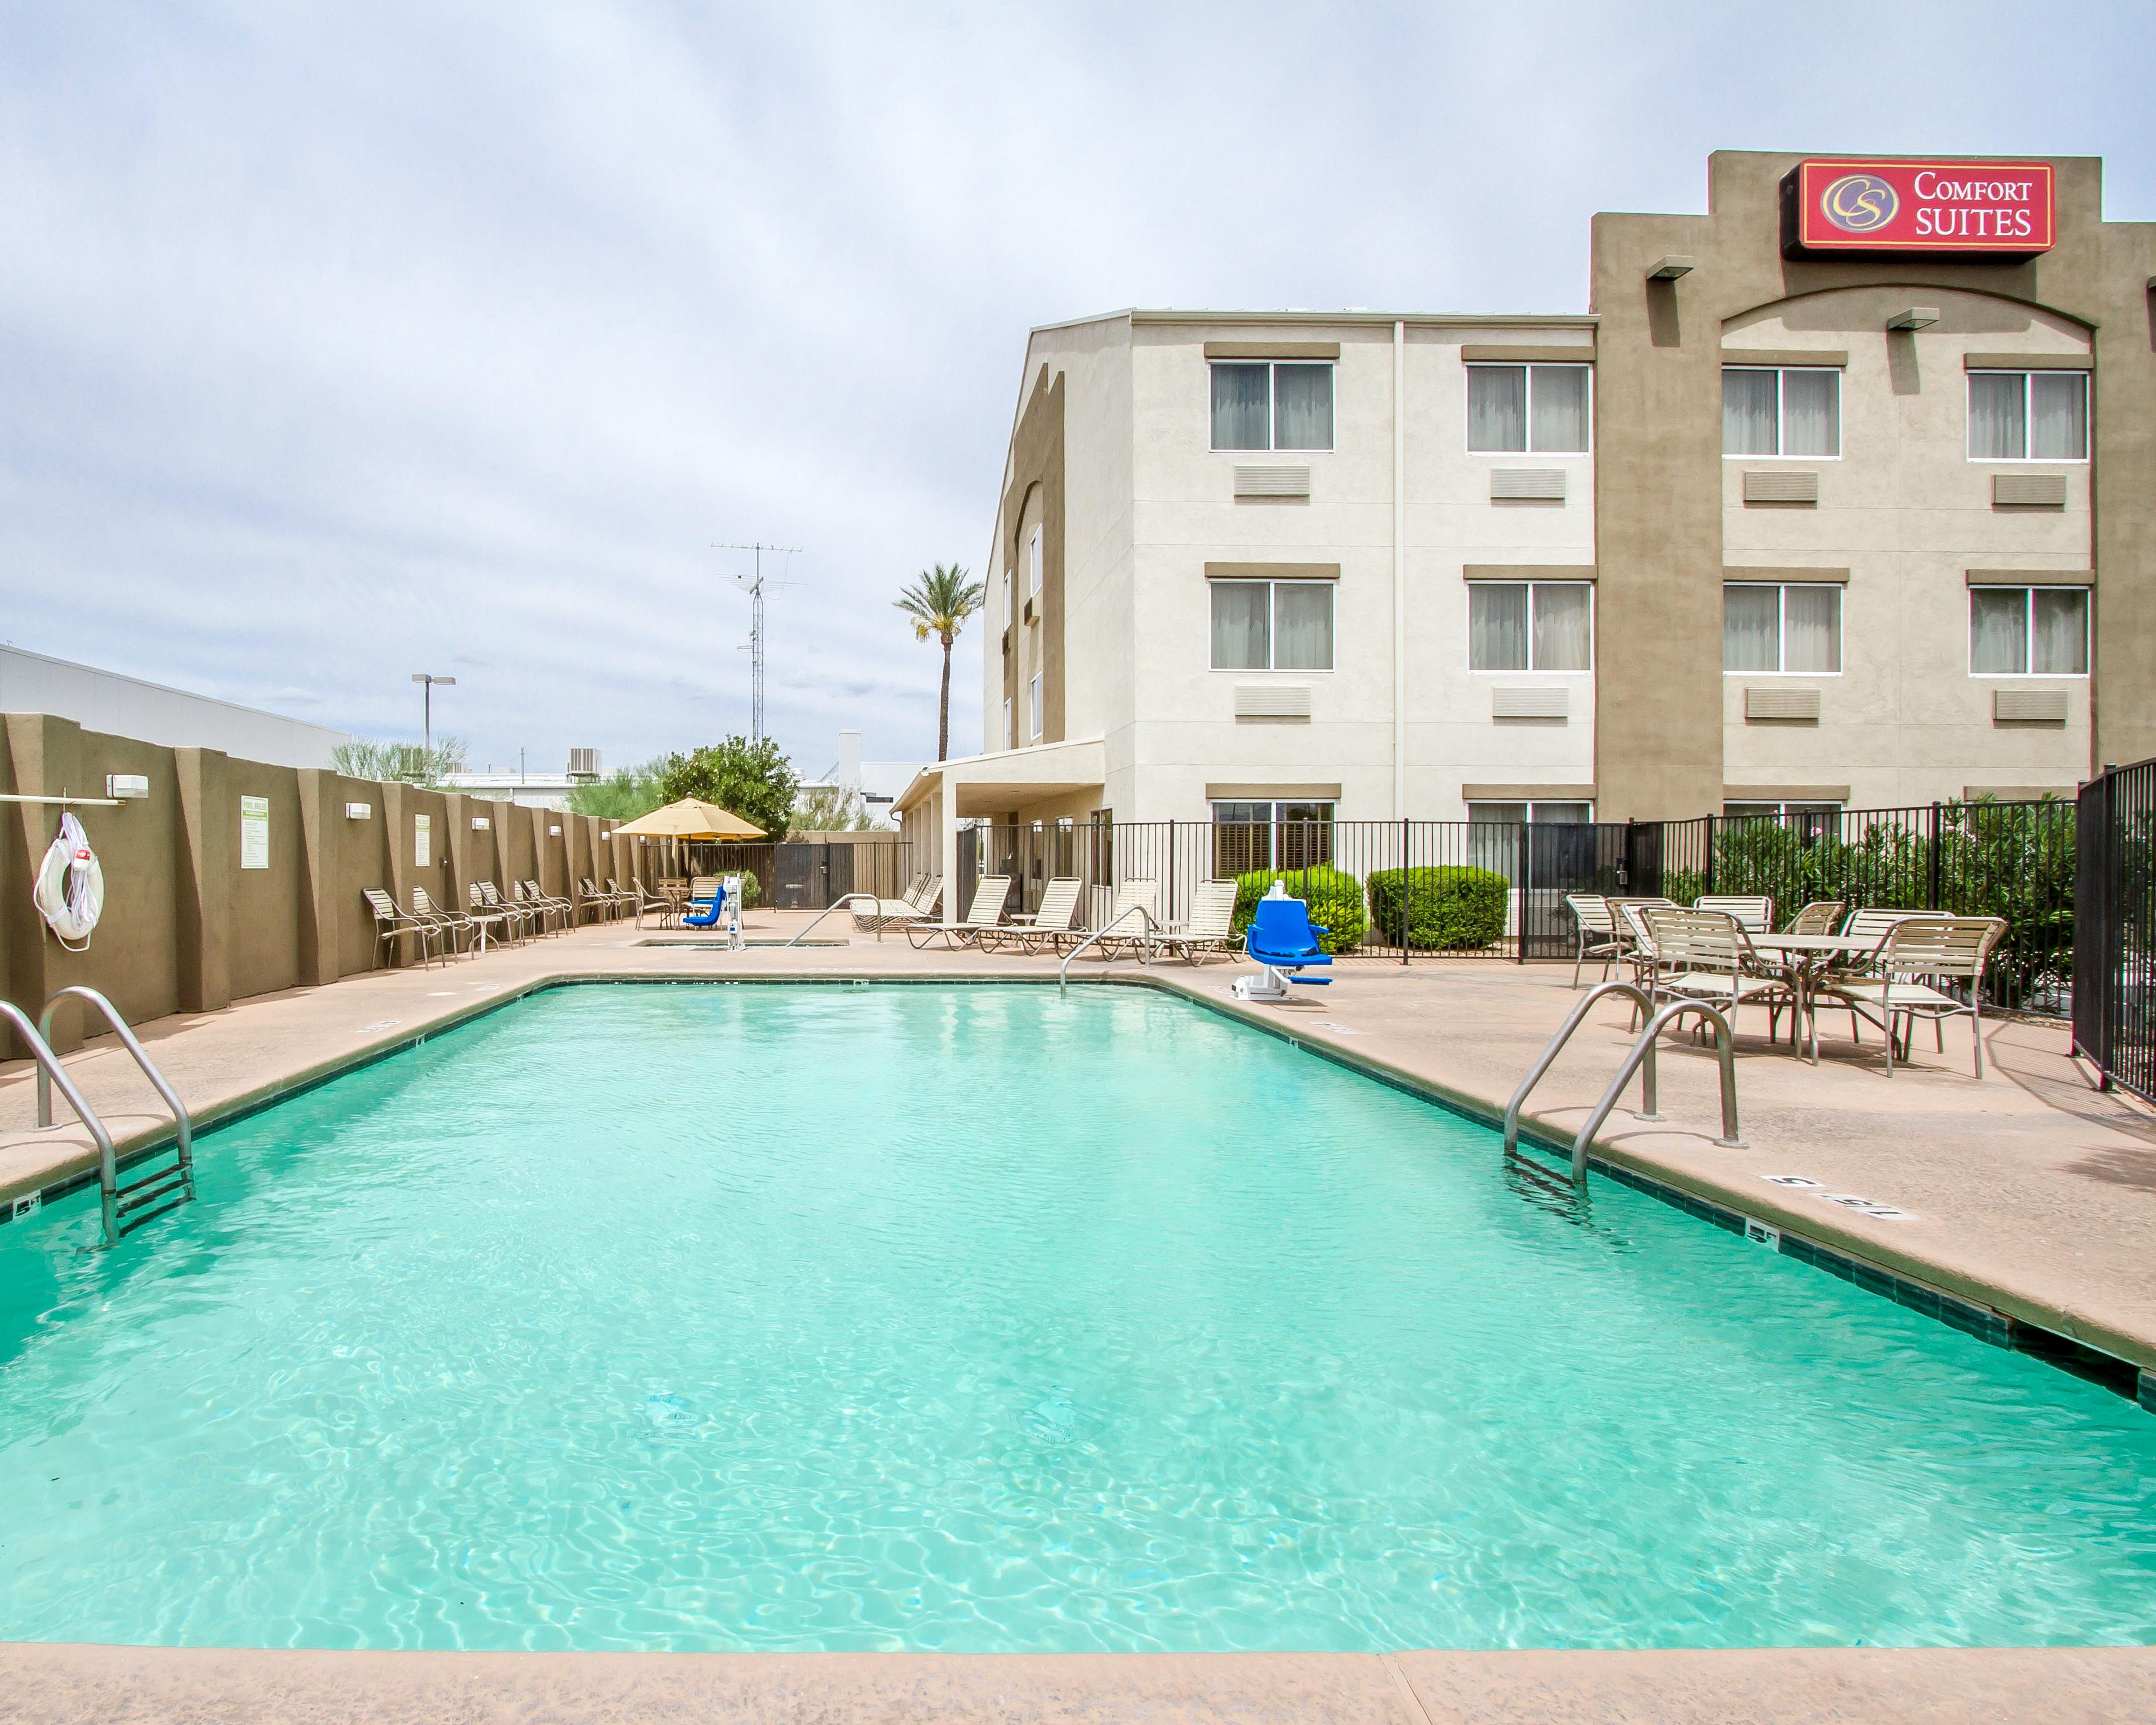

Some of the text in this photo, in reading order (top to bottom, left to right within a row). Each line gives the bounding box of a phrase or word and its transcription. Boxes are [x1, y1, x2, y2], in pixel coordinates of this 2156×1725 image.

[1916, 208, 2032, 237] SUITES
[16, 1200, 31, 1216] 5
[1746, 1225, 1767, 1243] 5
